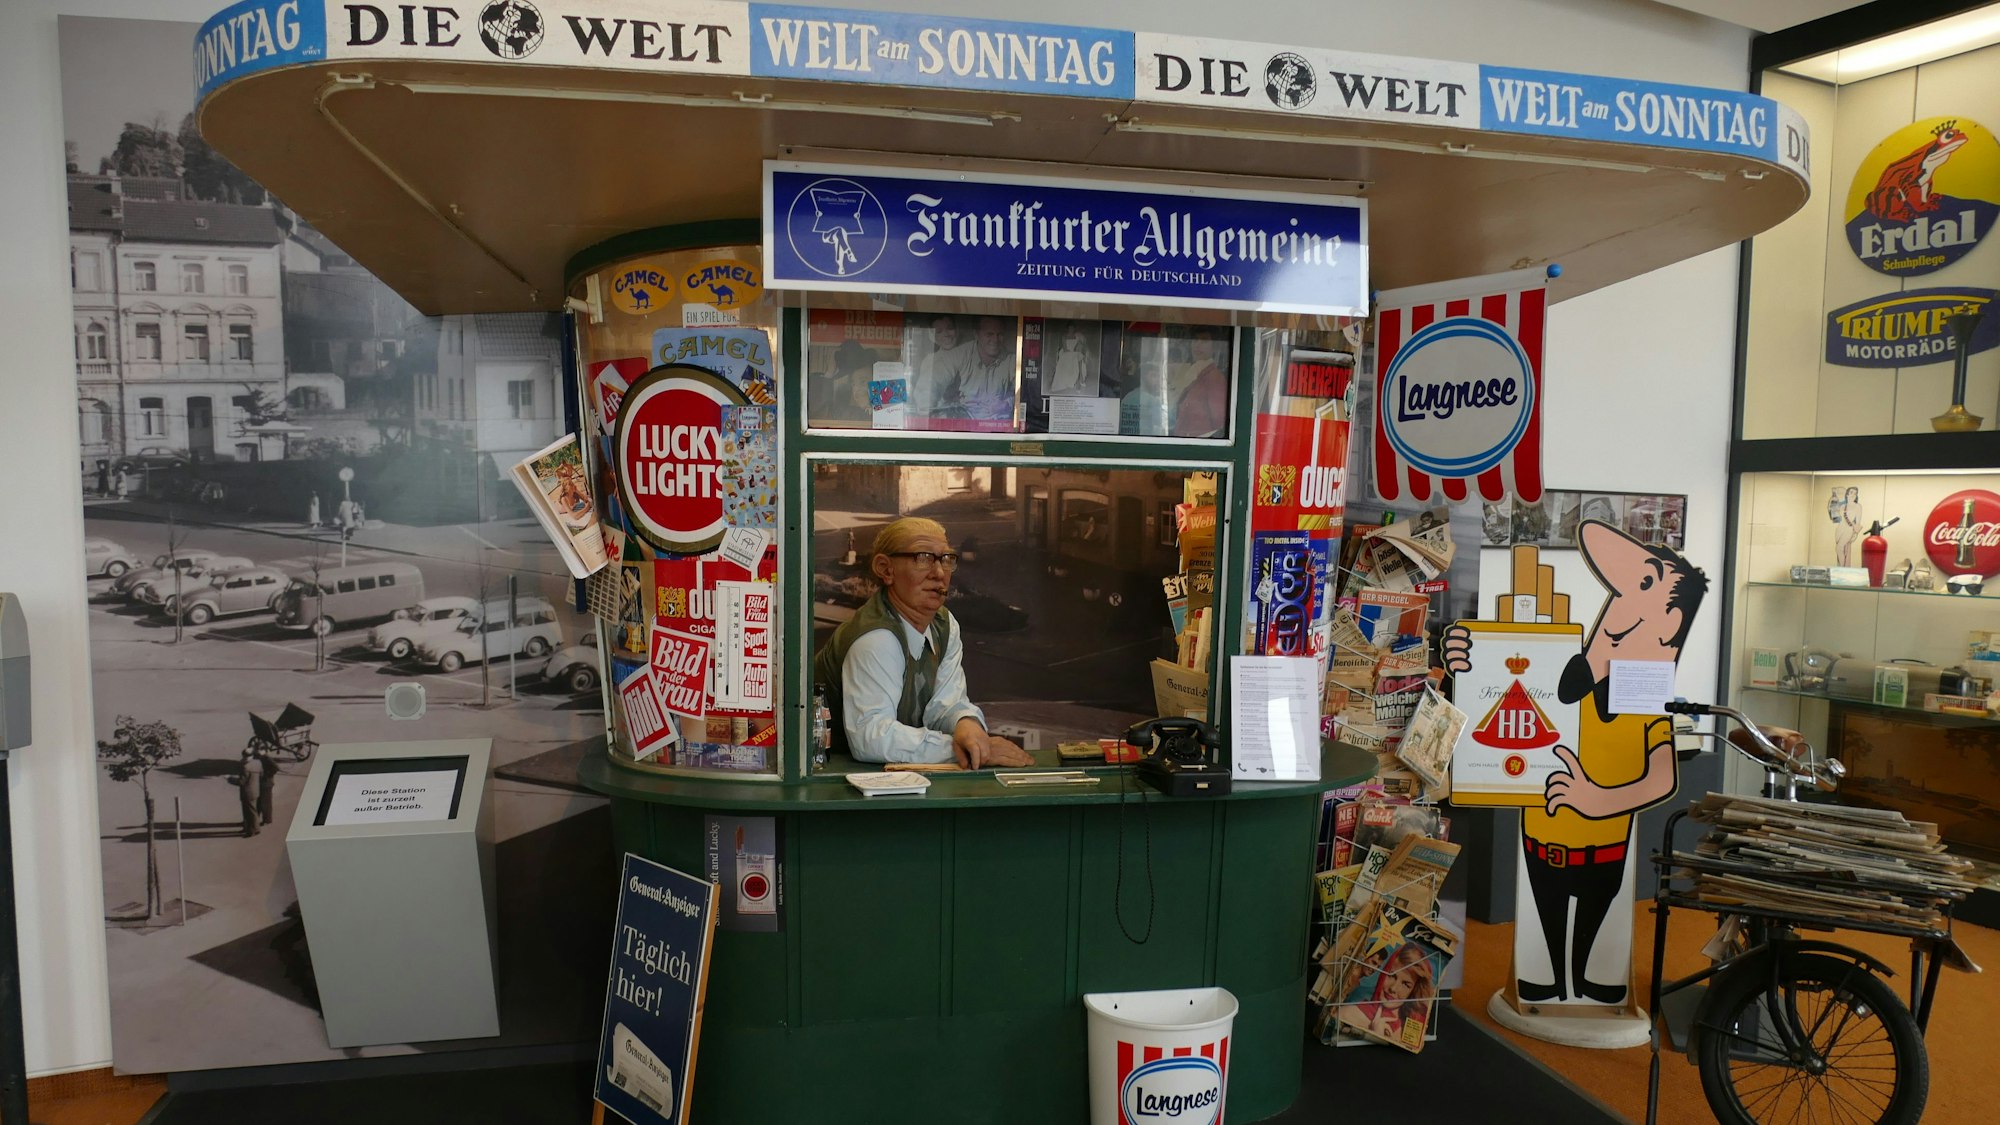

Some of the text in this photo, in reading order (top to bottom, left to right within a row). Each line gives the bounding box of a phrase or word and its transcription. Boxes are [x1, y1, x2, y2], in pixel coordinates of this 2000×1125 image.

[344, 4, 732, 64] DIE WELT
[760, 17, 1116, 87] WELT am SONNTAG
[1153, 53, 1467, 118] DIE WELT
[1487, 77, 1767, 149] WELT am SONNTAG
[905, 193, 1342, 269] Frankfurter Allgemeine
[1859, 209, 1977, 260] Erdal
[1883, 254, 1945, 271] Schuhpflege
[615, 269, 669, 293] CAMEL
[687, 265, 757, 289] CAMEL
[1016, 263, 1242, 287] ZEITUNG FÜR DEUTSCHLAND
[686, 311, 698, 324] EIN
[700, 311, 720, 324] SPIEL
[659, 335, 765, 366] CAMEL
[1846, 335, 1957, 360] MOTORRÄDE
[1398, 375, 1519, 423] Langnese
[639, 424, 722, 460] LUCKY
[1382, 559, 1402, 575] Welle
[1361, 592, 1409, 605] DER SPIEGEL
[1426, 585, 1444, 593] TAGE
[745, 595, 768, 609] Bild
[745, 610, 767, 621] Frau
[689, 624, 716, 634] CIGA
[744, 628, 768, 649] Sport
[653, 636, 706, 677] Bild
[1753, 651, 1777, 668] Henko
[668, 673, 687, 686] der
[744, 663, 767, 681] Auto
[656, 670, 701, 712] Frau
[744, 681, 767, 698] Bild
[1479, 686, 1554, 704] Kronenfilter
[625, 680, 664, 741] Bild
[752, 724, 776, 745] NEW
[1498, 709, 1537, 740] HB
[1363, 809, 1393, 824] Quick
[711, 821, 720, 851] Lucky.
[711, 852, 720, 870] and
[711, 871, 720, 885] oft
[623, 924, 692, 986] Täglich
[615, 966, 664, 1017] hier!
[1137, 1086, 1218, 1117] Langnese
